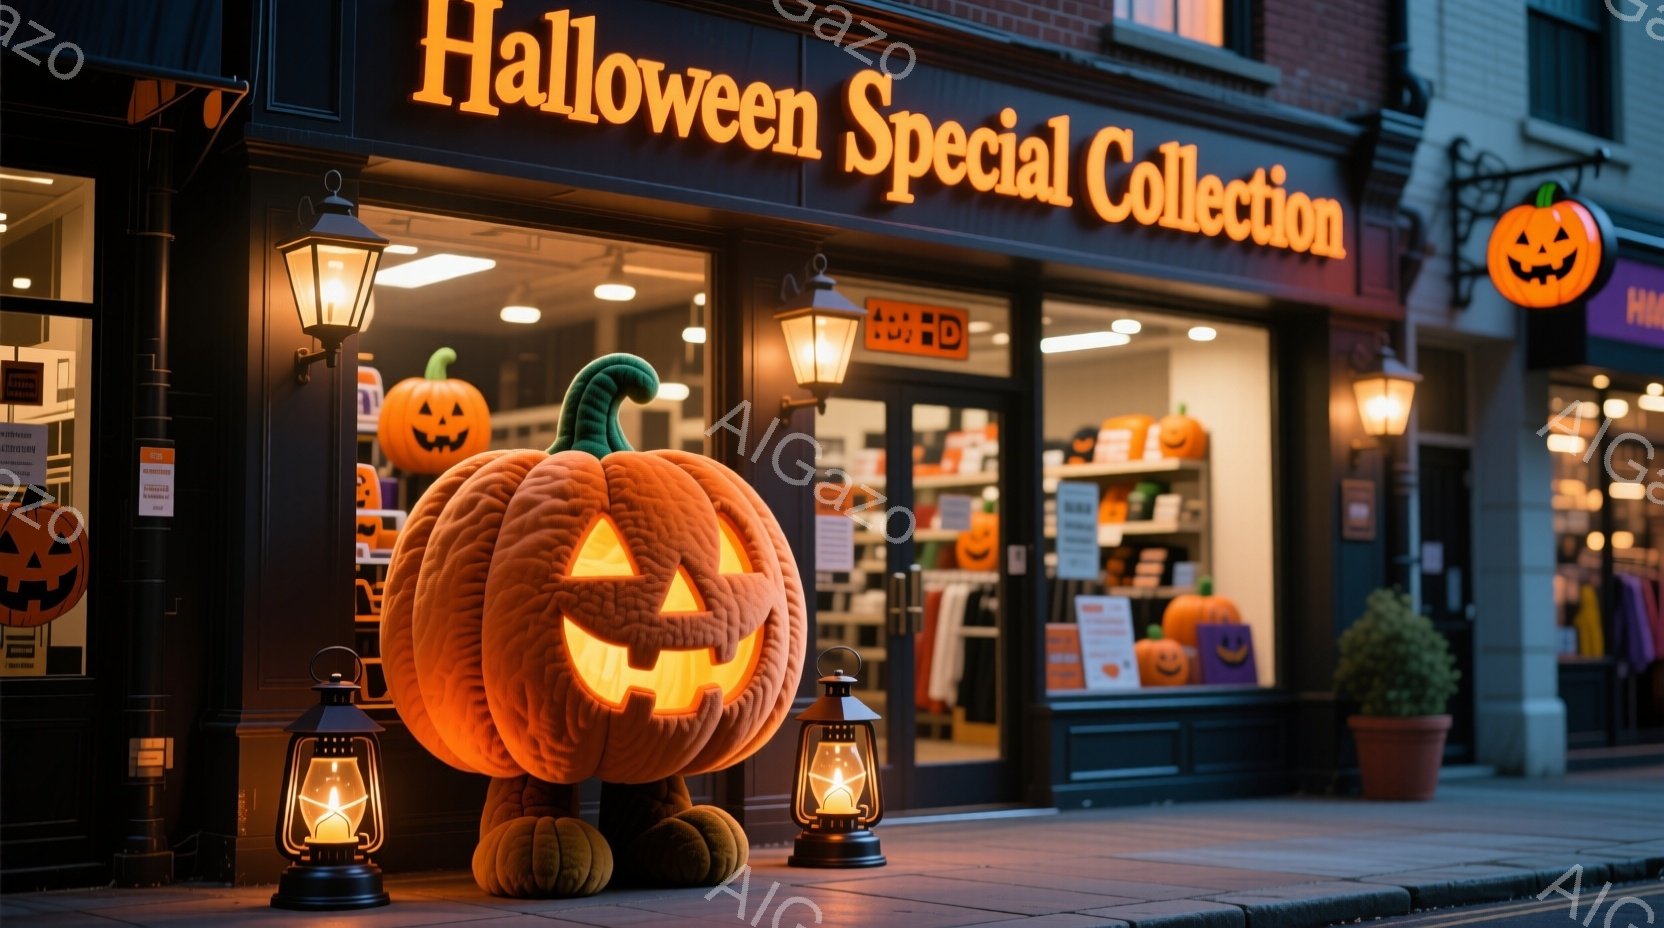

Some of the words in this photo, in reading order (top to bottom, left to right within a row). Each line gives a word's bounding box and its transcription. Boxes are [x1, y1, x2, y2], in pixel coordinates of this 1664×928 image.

[413, 0, 821, 159] Halloween
[845, 69, 1073, 204] Special
[1087, 126, 1346, 259] Collection
